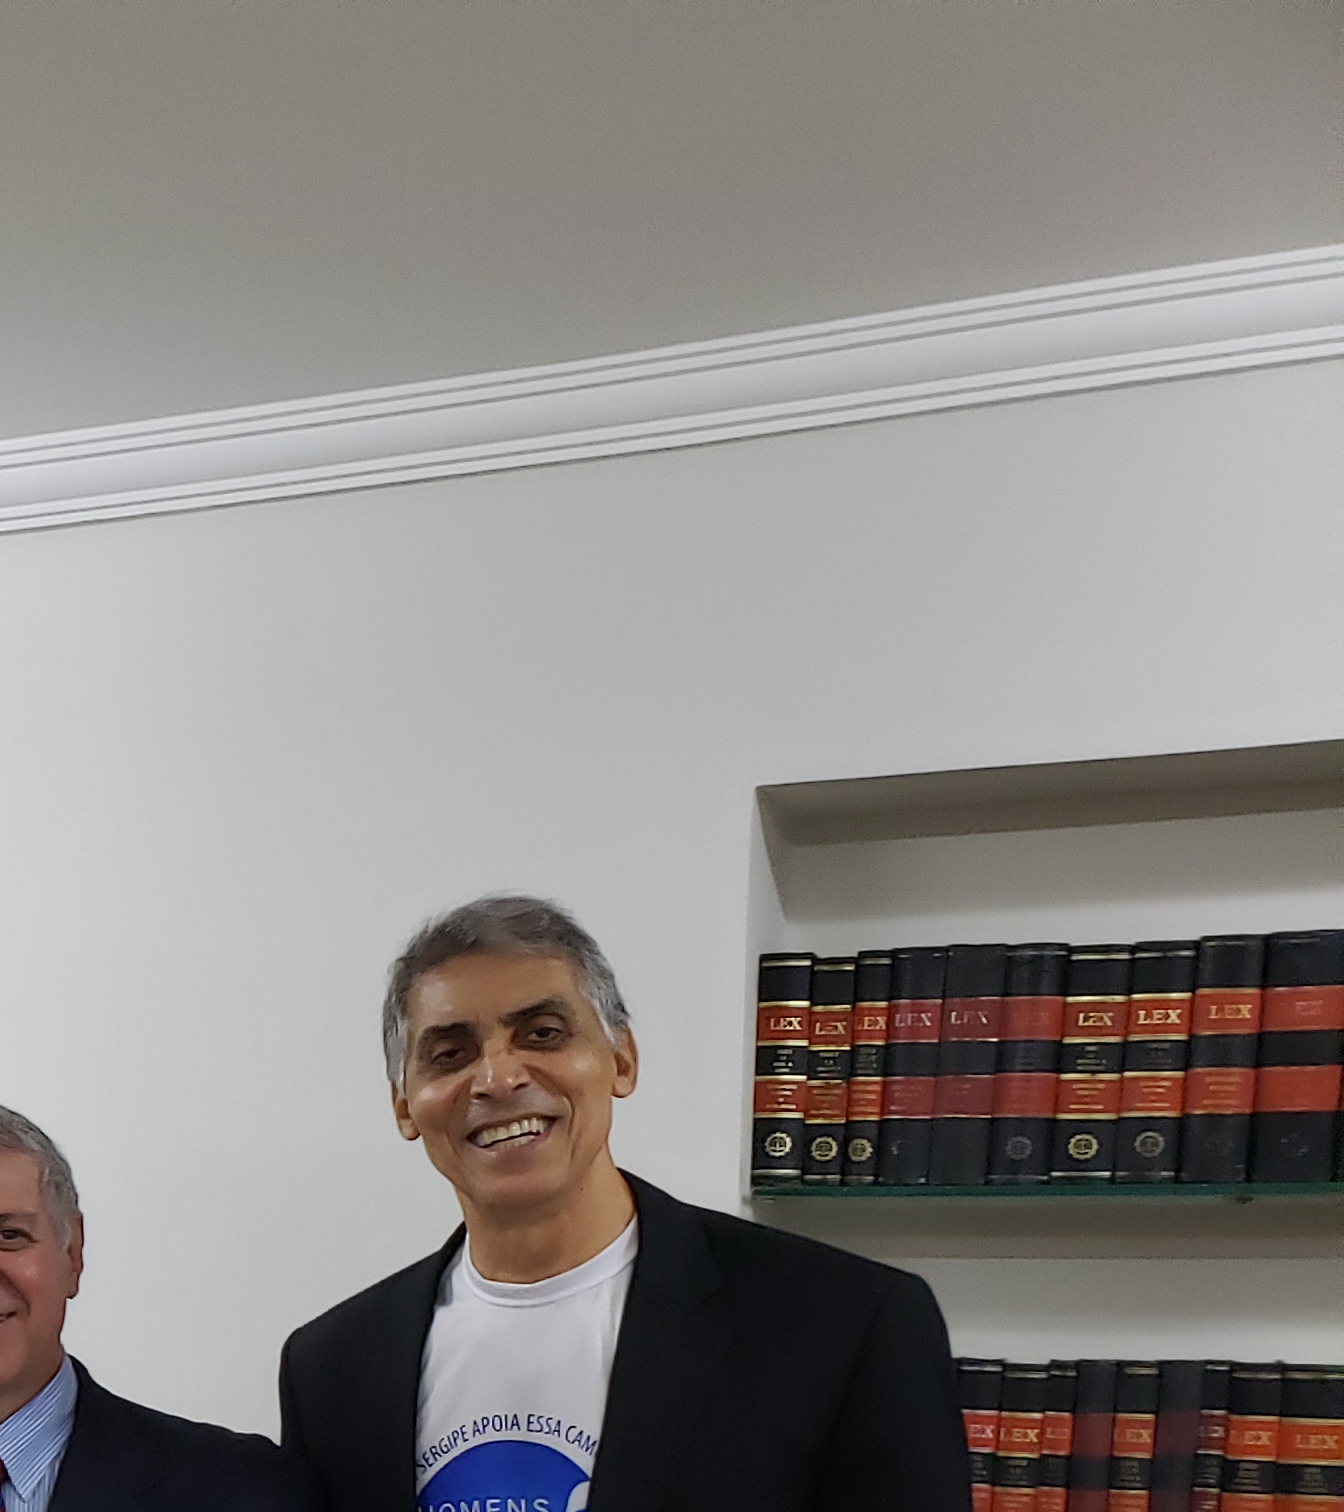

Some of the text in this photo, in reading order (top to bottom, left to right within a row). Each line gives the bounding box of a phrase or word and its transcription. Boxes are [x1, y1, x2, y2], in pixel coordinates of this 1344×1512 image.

[1137, 1009, 1182, 1025] LEX
[1208, 1004, 1253, 1019] LEX
[770, 1017, 803, 1031] LEX
[894, 1012, 932, 1027] LEX
[1078, 1012, 1114, 1027] LEX
[814, 1022, 848, 1035] LEX
[999, 1427, 1040, 1442] LEX
[416, 1424, 469, 1476] SERGIPE
[472, 1413, 521, 1438] APOIA
[526, 1413, 562, 1437] ESSA
